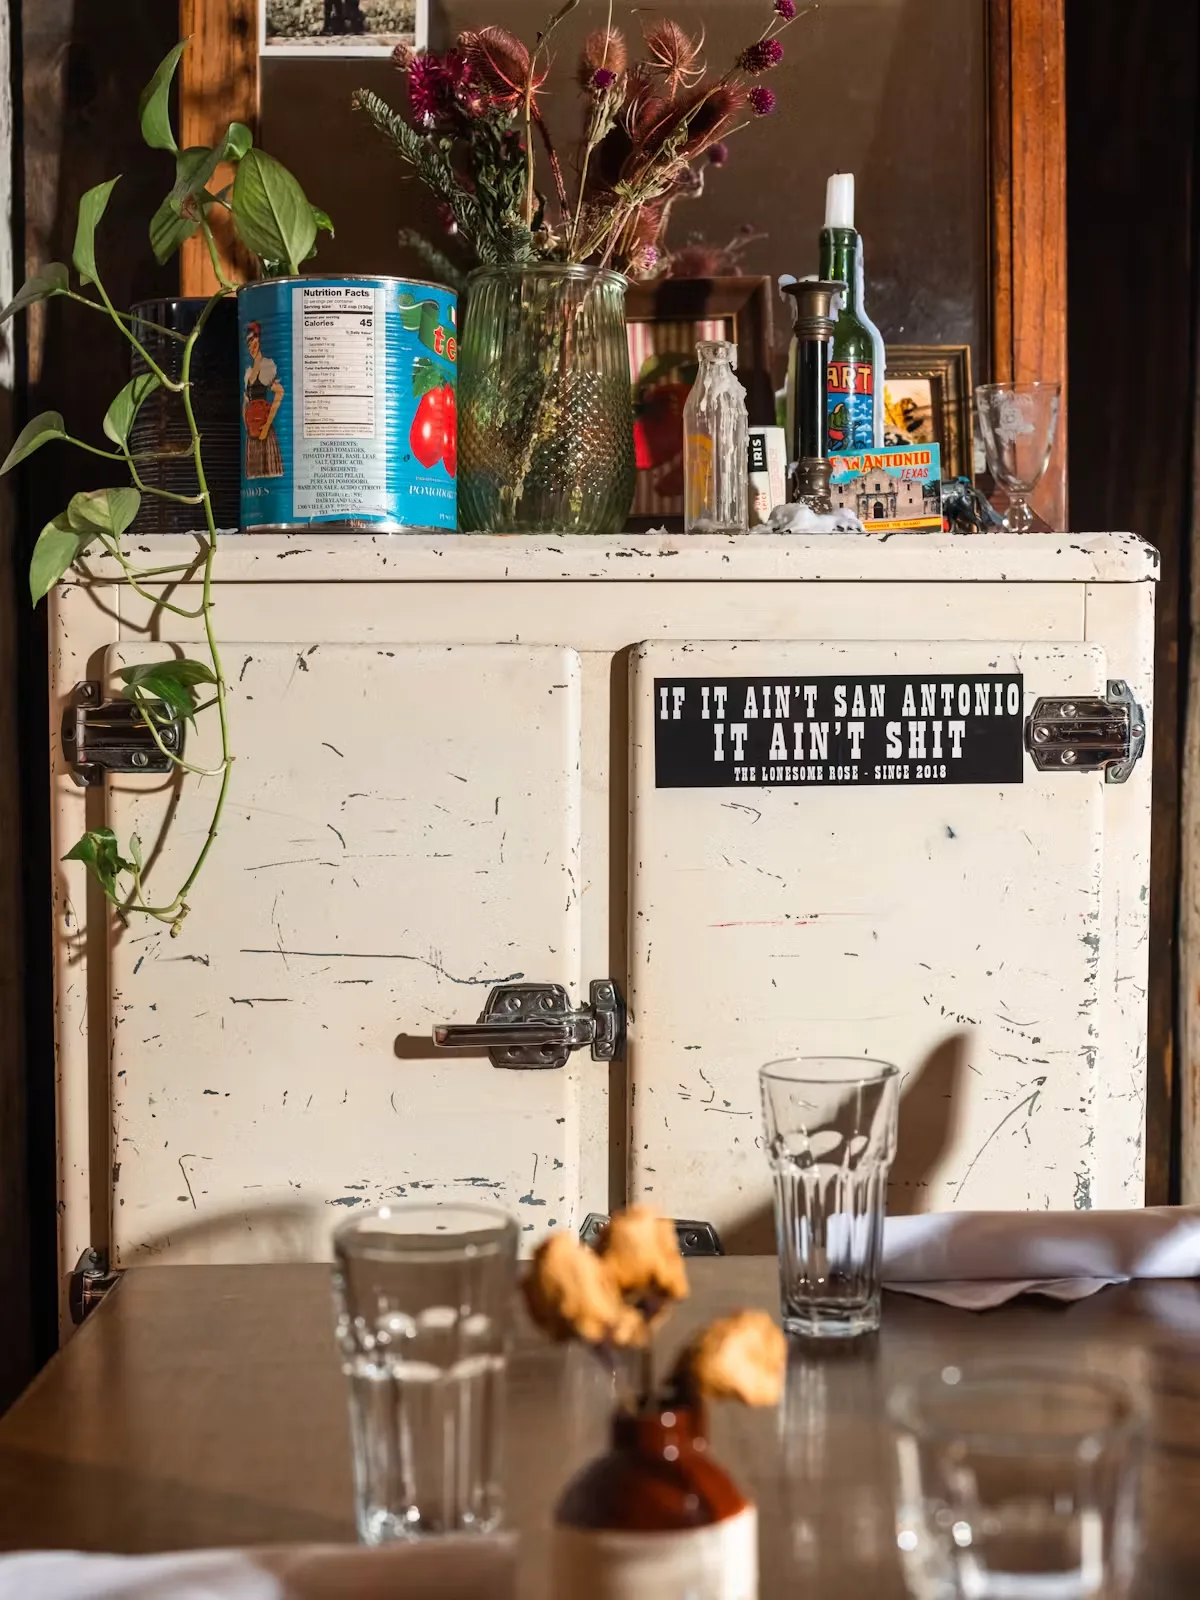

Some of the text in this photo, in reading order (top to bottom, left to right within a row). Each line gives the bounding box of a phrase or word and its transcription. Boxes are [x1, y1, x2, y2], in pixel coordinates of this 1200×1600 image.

[345, 289, 370, 297] Facts
[753, 438, 763, 466] IRIS
[861, 451, 931, 473] ANTONIO
[901, 468, 929, 479] TEXAS
[660, 682, 1020, 720] IF IT AIN'T SAN ANTONIO
[714, 720, 966, 761] IT AIN'T SHIT
[734, 766, 756, 782] THE
[762, 766, 823, 782] LONESOME
[829, 765, 858, 781] ROSE
[874, 765, 910, 780] SINCE
[915, 765, 947, 779] 2018
